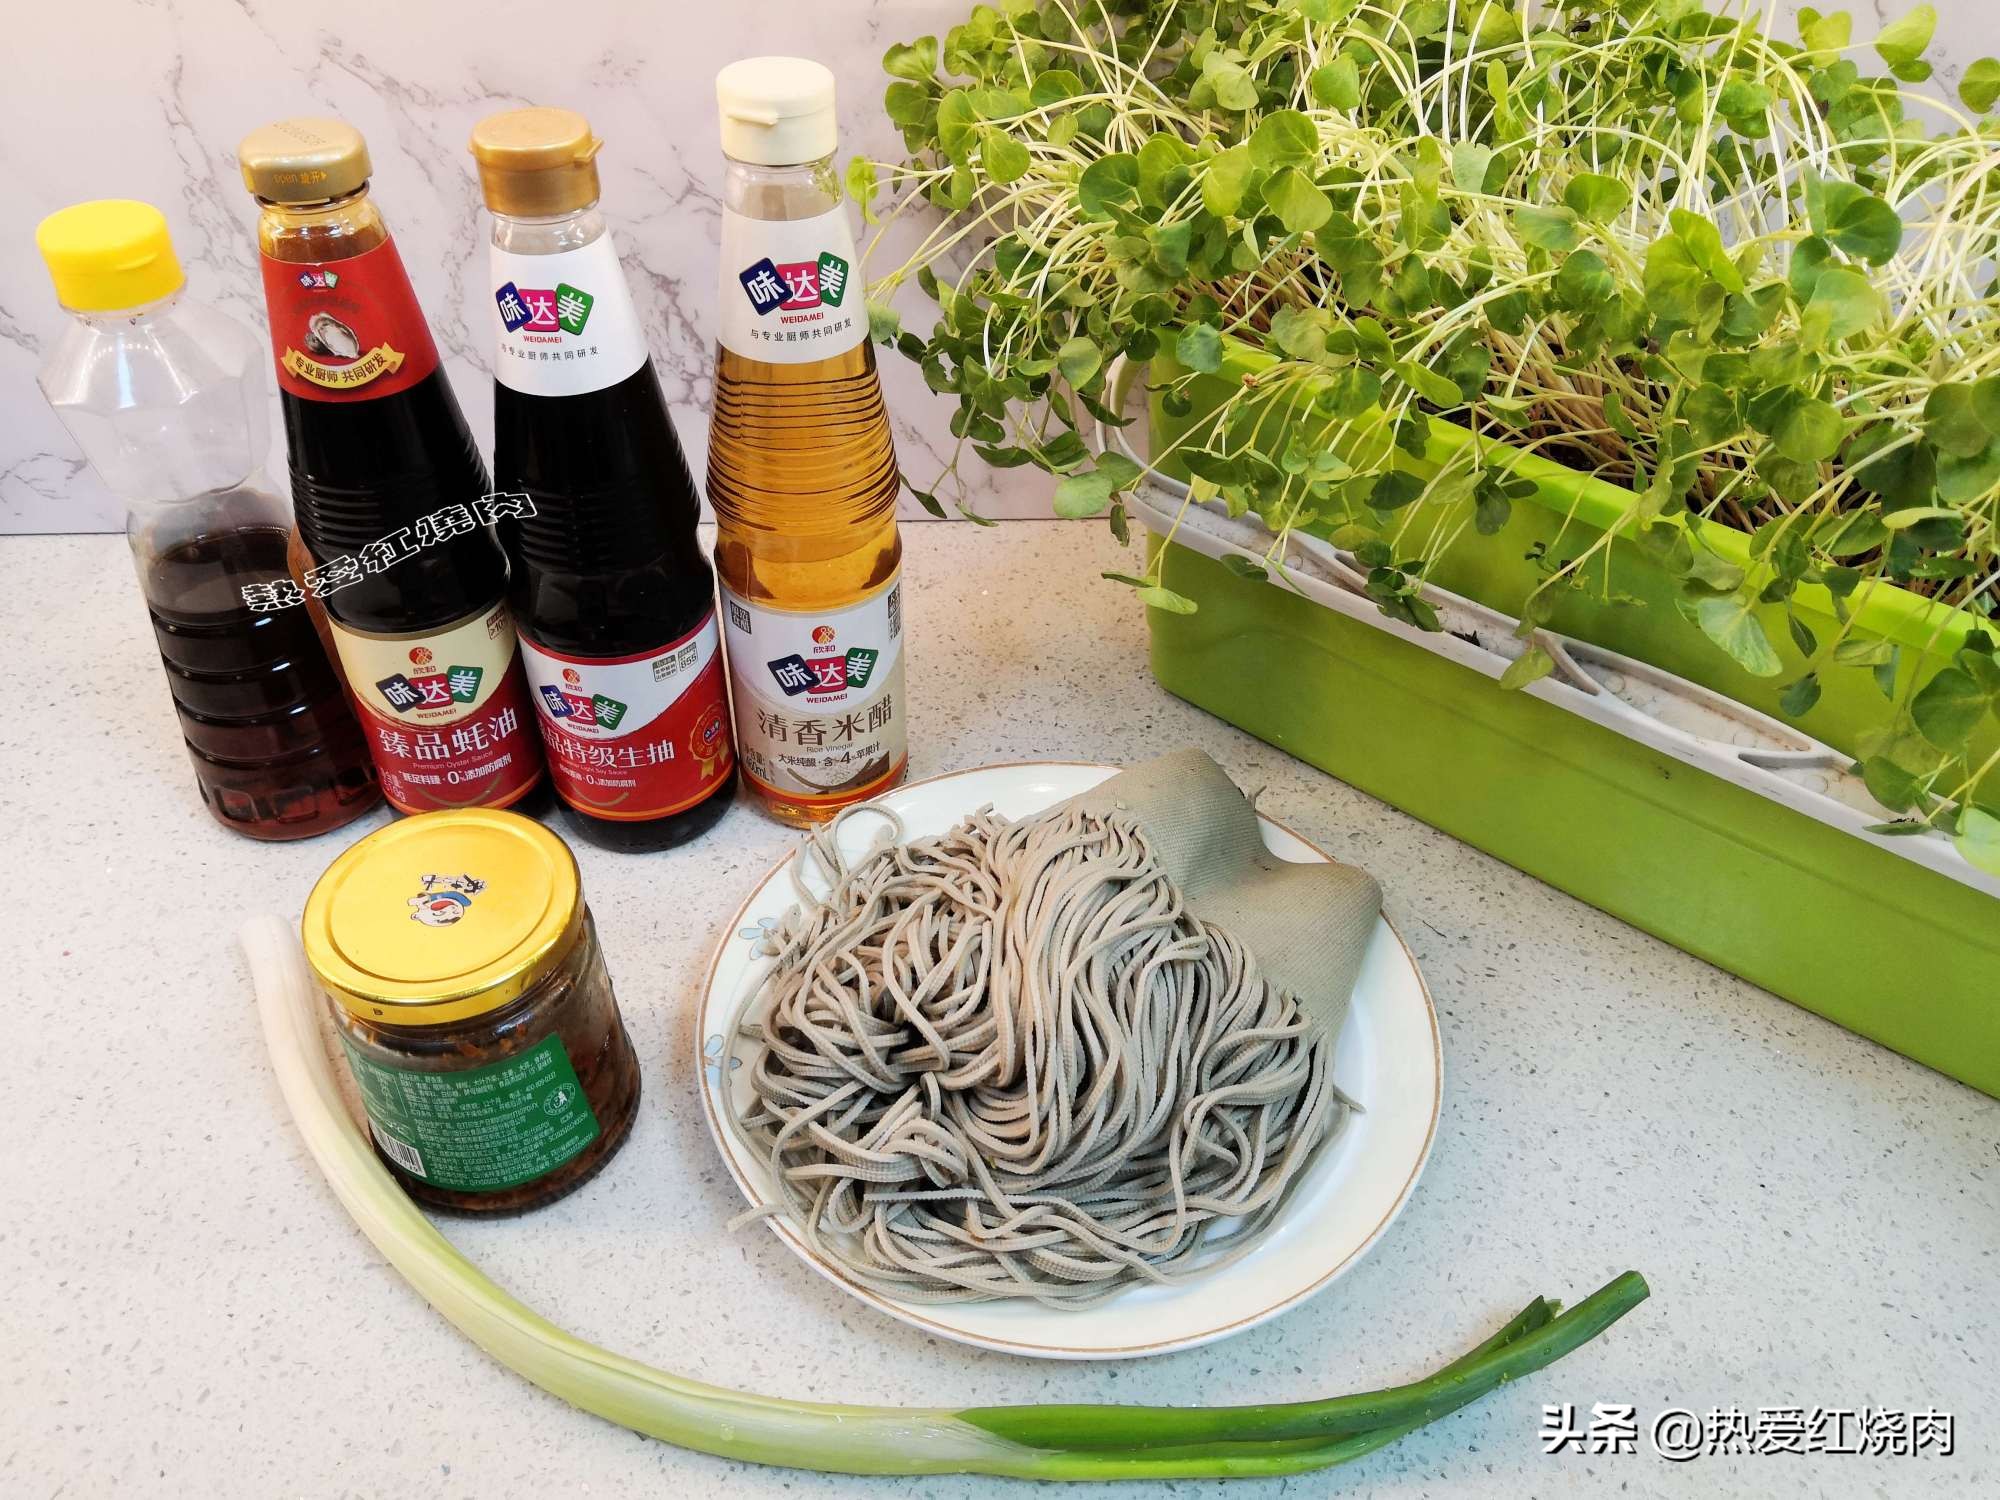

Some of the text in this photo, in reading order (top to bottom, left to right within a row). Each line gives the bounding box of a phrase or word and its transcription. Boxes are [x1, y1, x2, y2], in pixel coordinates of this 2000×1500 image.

[747, 259, 844, 304] 味达美
[499, 292, 587, 327] 味达美
[780, 312, 824, 325] WEIDAMEI
[523, 335, 562, 344] WEIDAMEI
[750, 318, 852, 342] 与专业厨师共同研发
[295, 353, 388, 383] 专业厨师 共同研发
[813, 644, 836, 654] 欣和
[775, 653, 871, 688] 味达美
[384, 670, 478, 706] 味达美
[806, 693, 848, 704] WEIDAMEI
[416, 709, 457, 720] WEIDAMEI
[544, 690, 621, 725] 味达美
[756, 693, 892, 746] 清香米醋
[377, 707, 518, 761] 臻品蚝油
[825, 742, 854, 753] Vinegar
[412, 762, 445, 771] Premium
[446, 758, 470, 771] Oyster
